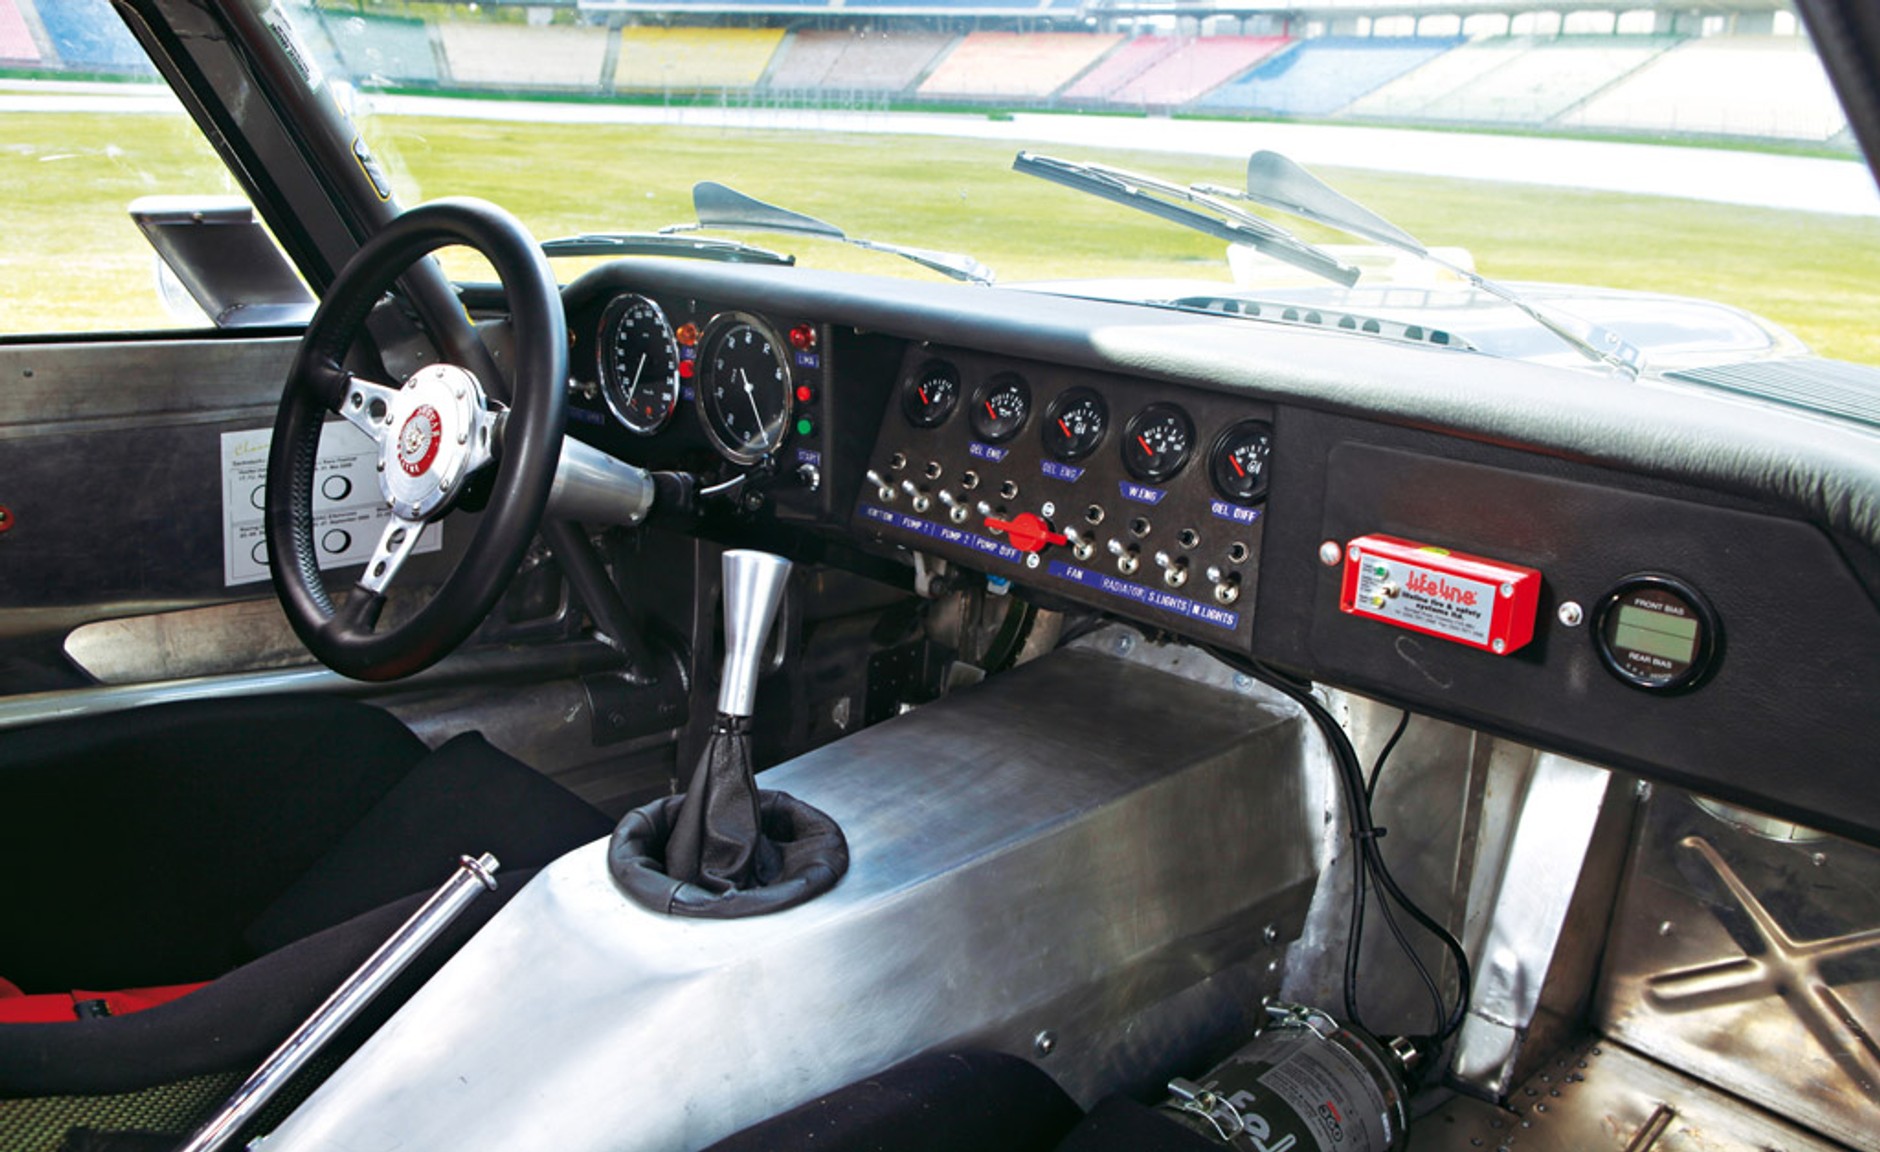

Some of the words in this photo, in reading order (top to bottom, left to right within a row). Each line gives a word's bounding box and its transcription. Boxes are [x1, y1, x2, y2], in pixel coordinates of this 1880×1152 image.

[1233, 507, 1257, 522] DIFF
[901, 517, 923, 530] PUMP
[940, 527, 962, 541] PUMP
[963, 534, 970, 545] 2
[976, 537, 998, 552] PUMP
[998, 545, 1017, 559] DIFF
[1065, 566, 1085, 580] FAN
[1101, 577, 1145, 598] RADIATOR
[1415, 602, 1449, 617] systems
[1430, 598, 1445, 608] fire
[1455, 605, 1482, 620] safety
[1634, 598, 1663, 610] FRONT
[1664, 604, 1684, 615] BIAS
[1628, 652, 1651, 663] REAR
[1652, 658, 1672, 669] BIAS
